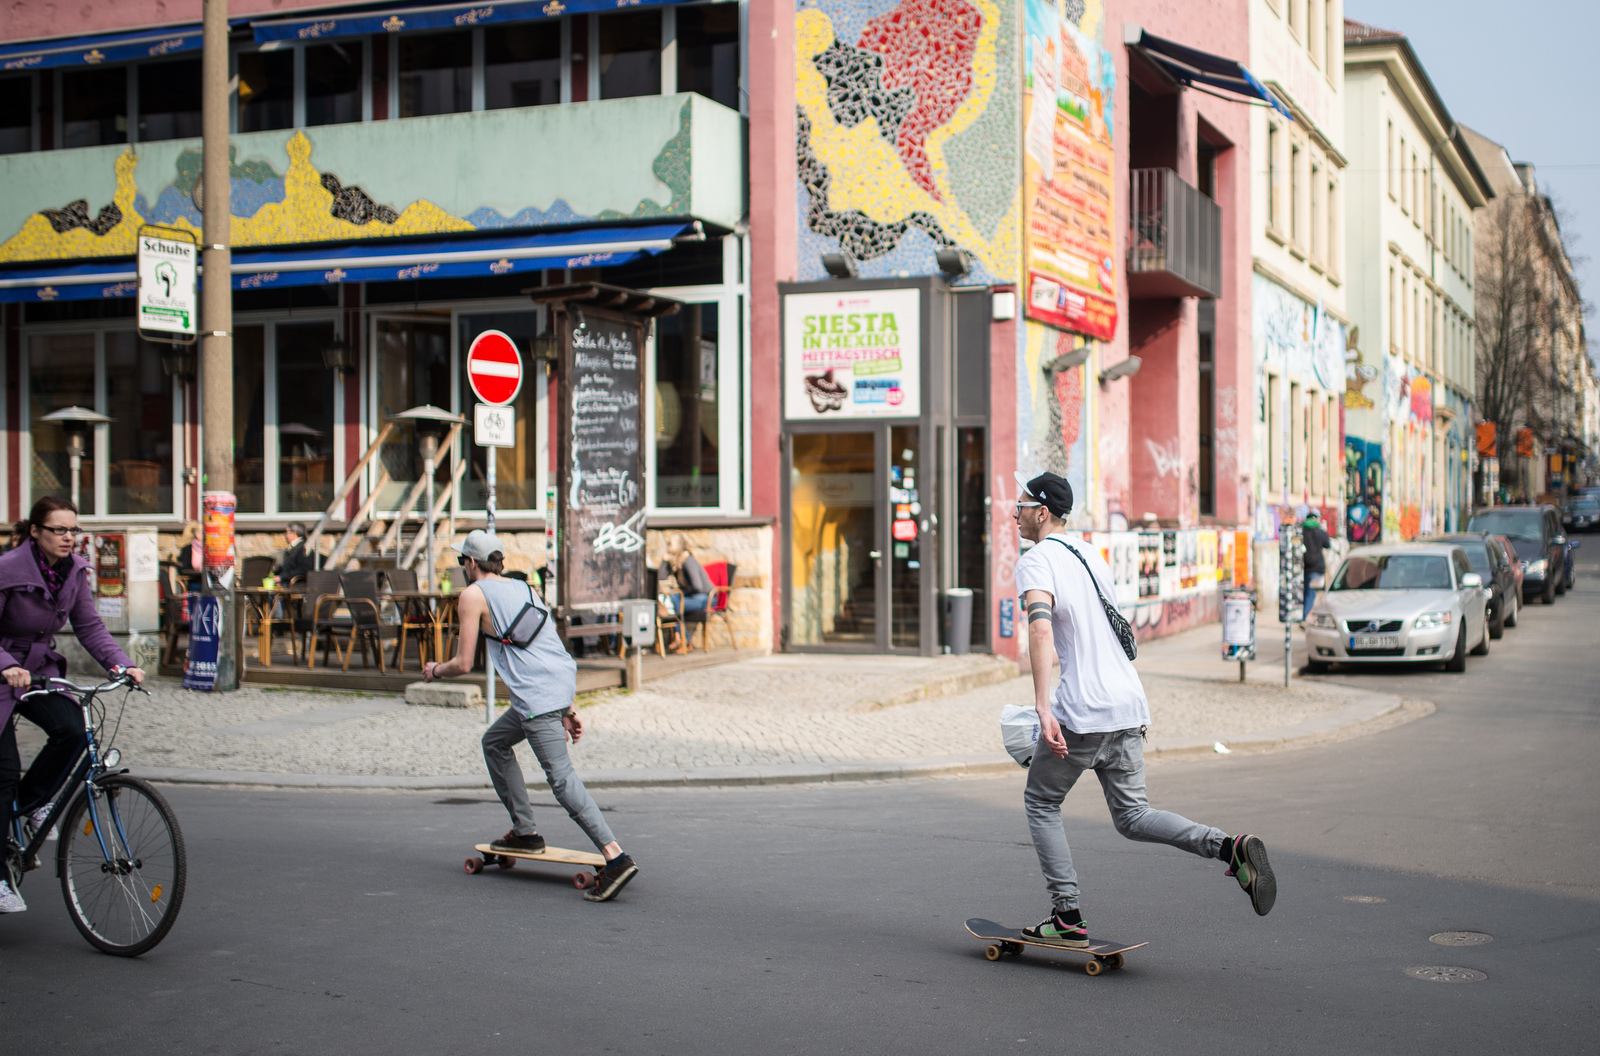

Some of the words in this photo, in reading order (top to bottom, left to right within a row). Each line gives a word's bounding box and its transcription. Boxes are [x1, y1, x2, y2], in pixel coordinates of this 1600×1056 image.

[143, 240, 190, 255] Schuhe
[803, 312, 898, 334] SIESTA
[803, 334, 821, 349] IN
[827, 333, 899, 348] MEXIKO
[803, 348, 900, 361] MITTAGSTISCH
